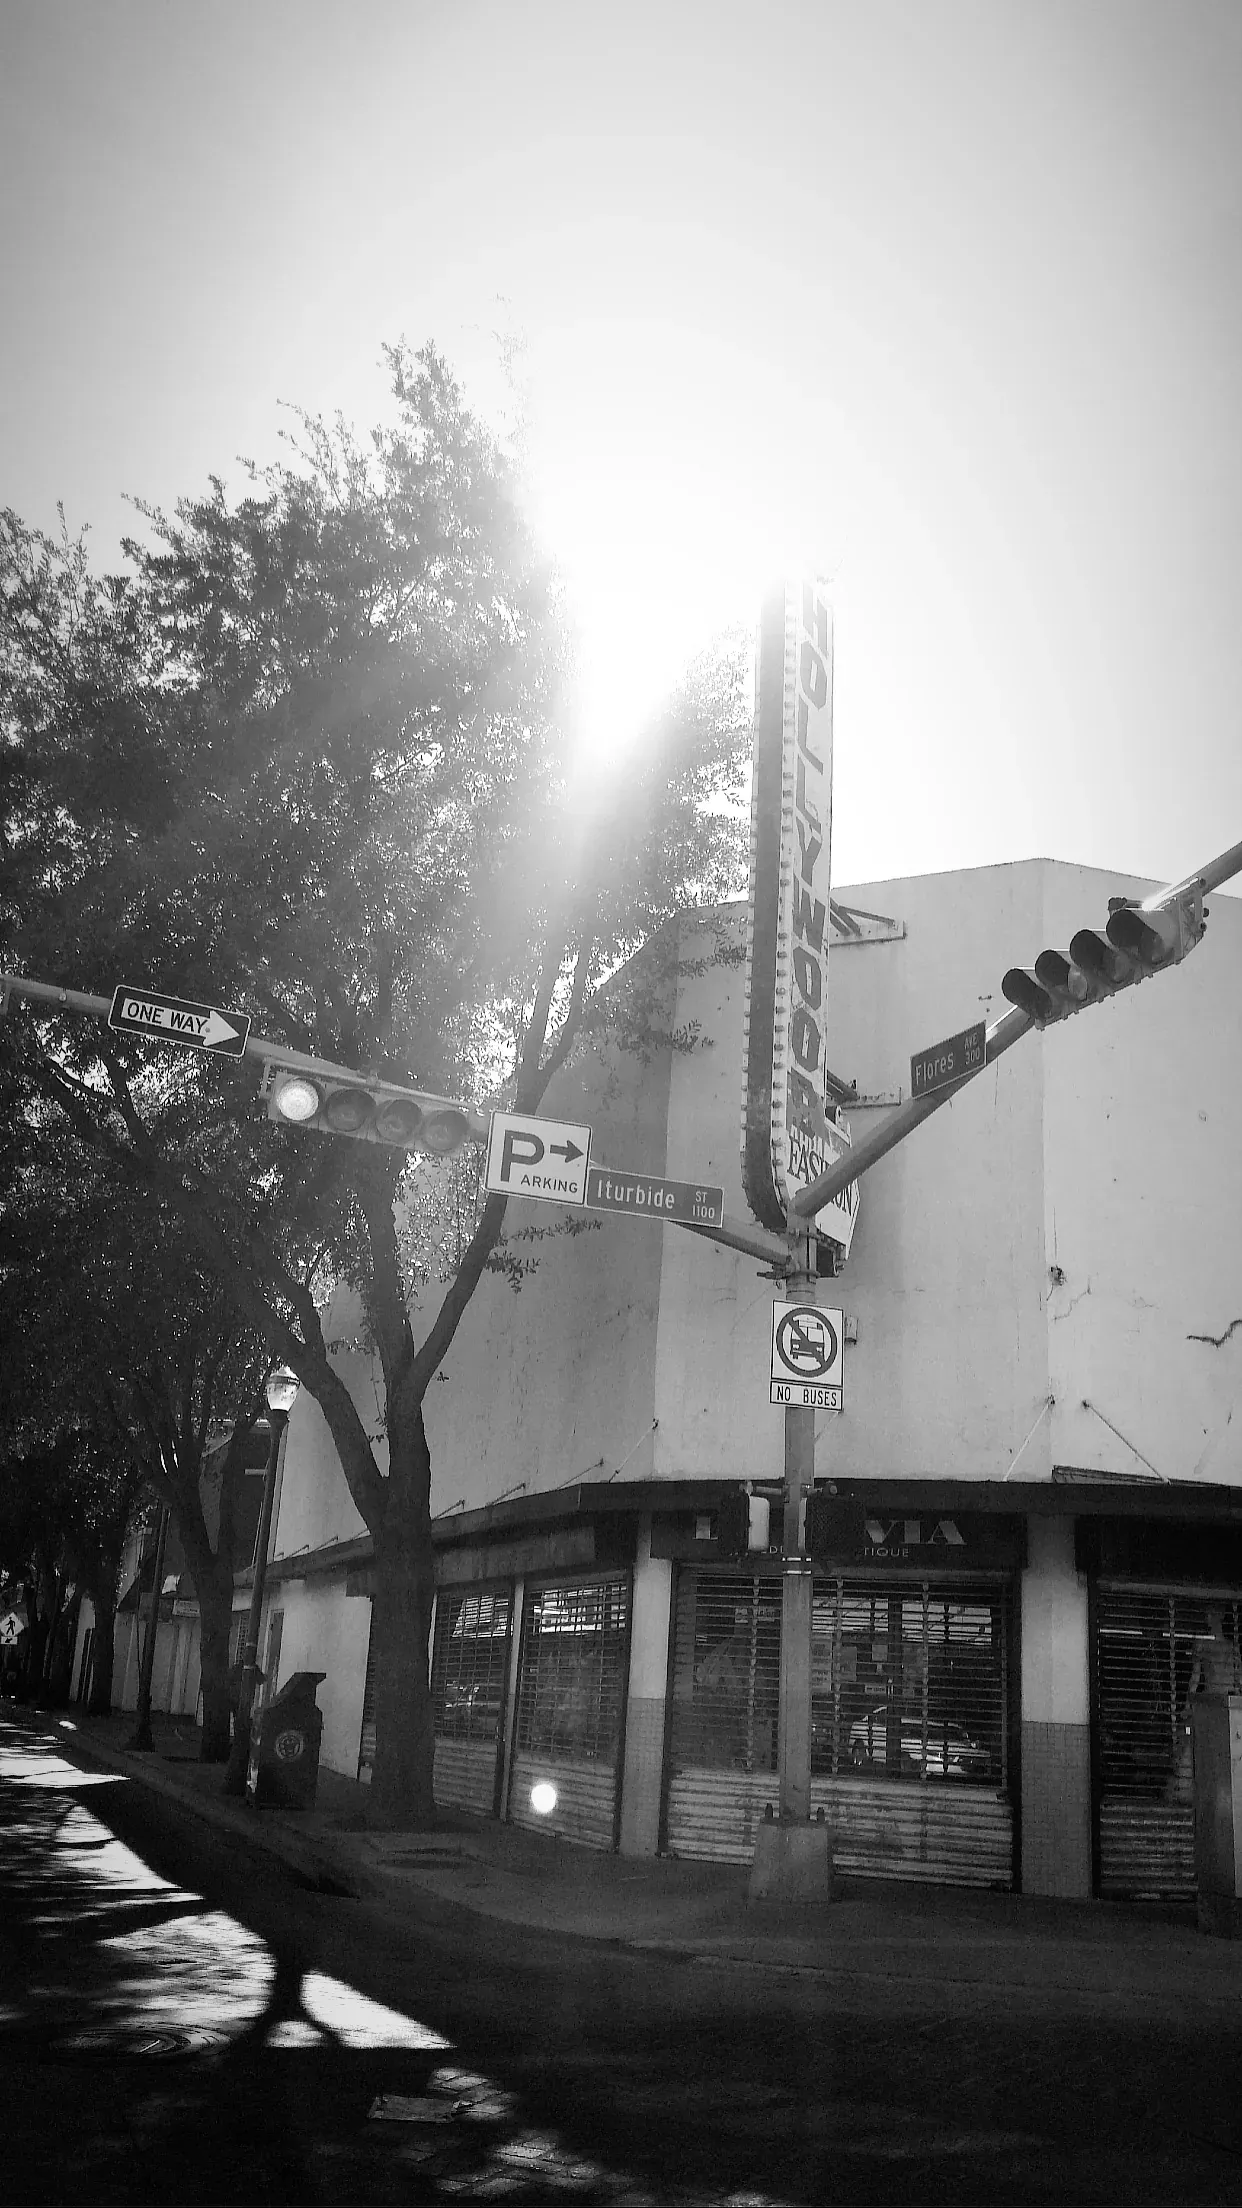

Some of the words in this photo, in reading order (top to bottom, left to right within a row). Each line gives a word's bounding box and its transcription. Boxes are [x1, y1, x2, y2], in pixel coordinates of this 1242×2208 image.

[127, 1002, 165, 1025] ONE
[170, 1011, 208, 1034] WAY
[915, 1052, 954, 1087] Flores
[964, 1032, 978, 1050] AVE
[965, 1045, 981, 1065] 300
[597, 1179, 675, 1209] Iturbide
[695, 1190, 708, 1203] ST
[692, 1204, 716, 1219] 1100
[776, 1385, 791, 1402] NO
[803, 1388, 837, 1407] BUSES
[863, 1519, 967, 1546] VIA
